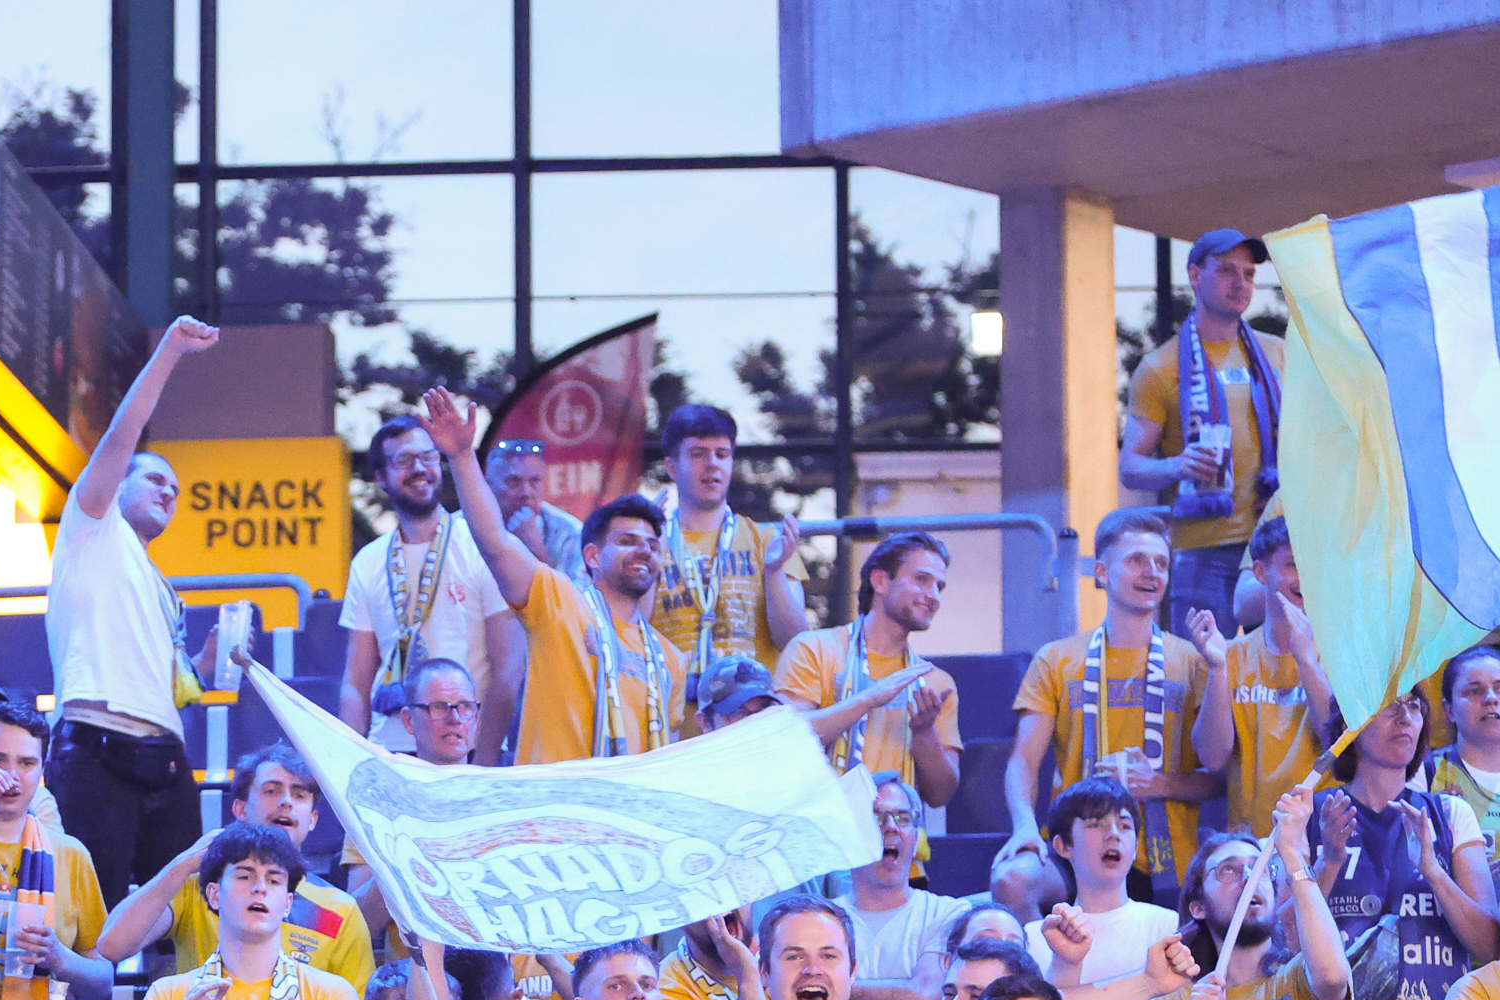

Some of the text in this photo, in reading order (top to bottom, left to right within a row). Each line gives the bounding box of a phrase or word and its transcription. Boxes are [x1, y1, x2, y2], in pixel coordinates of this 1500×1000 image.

[190, 479, 324, 511] SNACK
[205, 516, 325, 548] POINT
[355, 804, 787, 901] TORNADOS
[1399, 892, 1443, 917] RE
[1402, 935, 1453, 967] alia
[518, 974, 553, 998] AND
